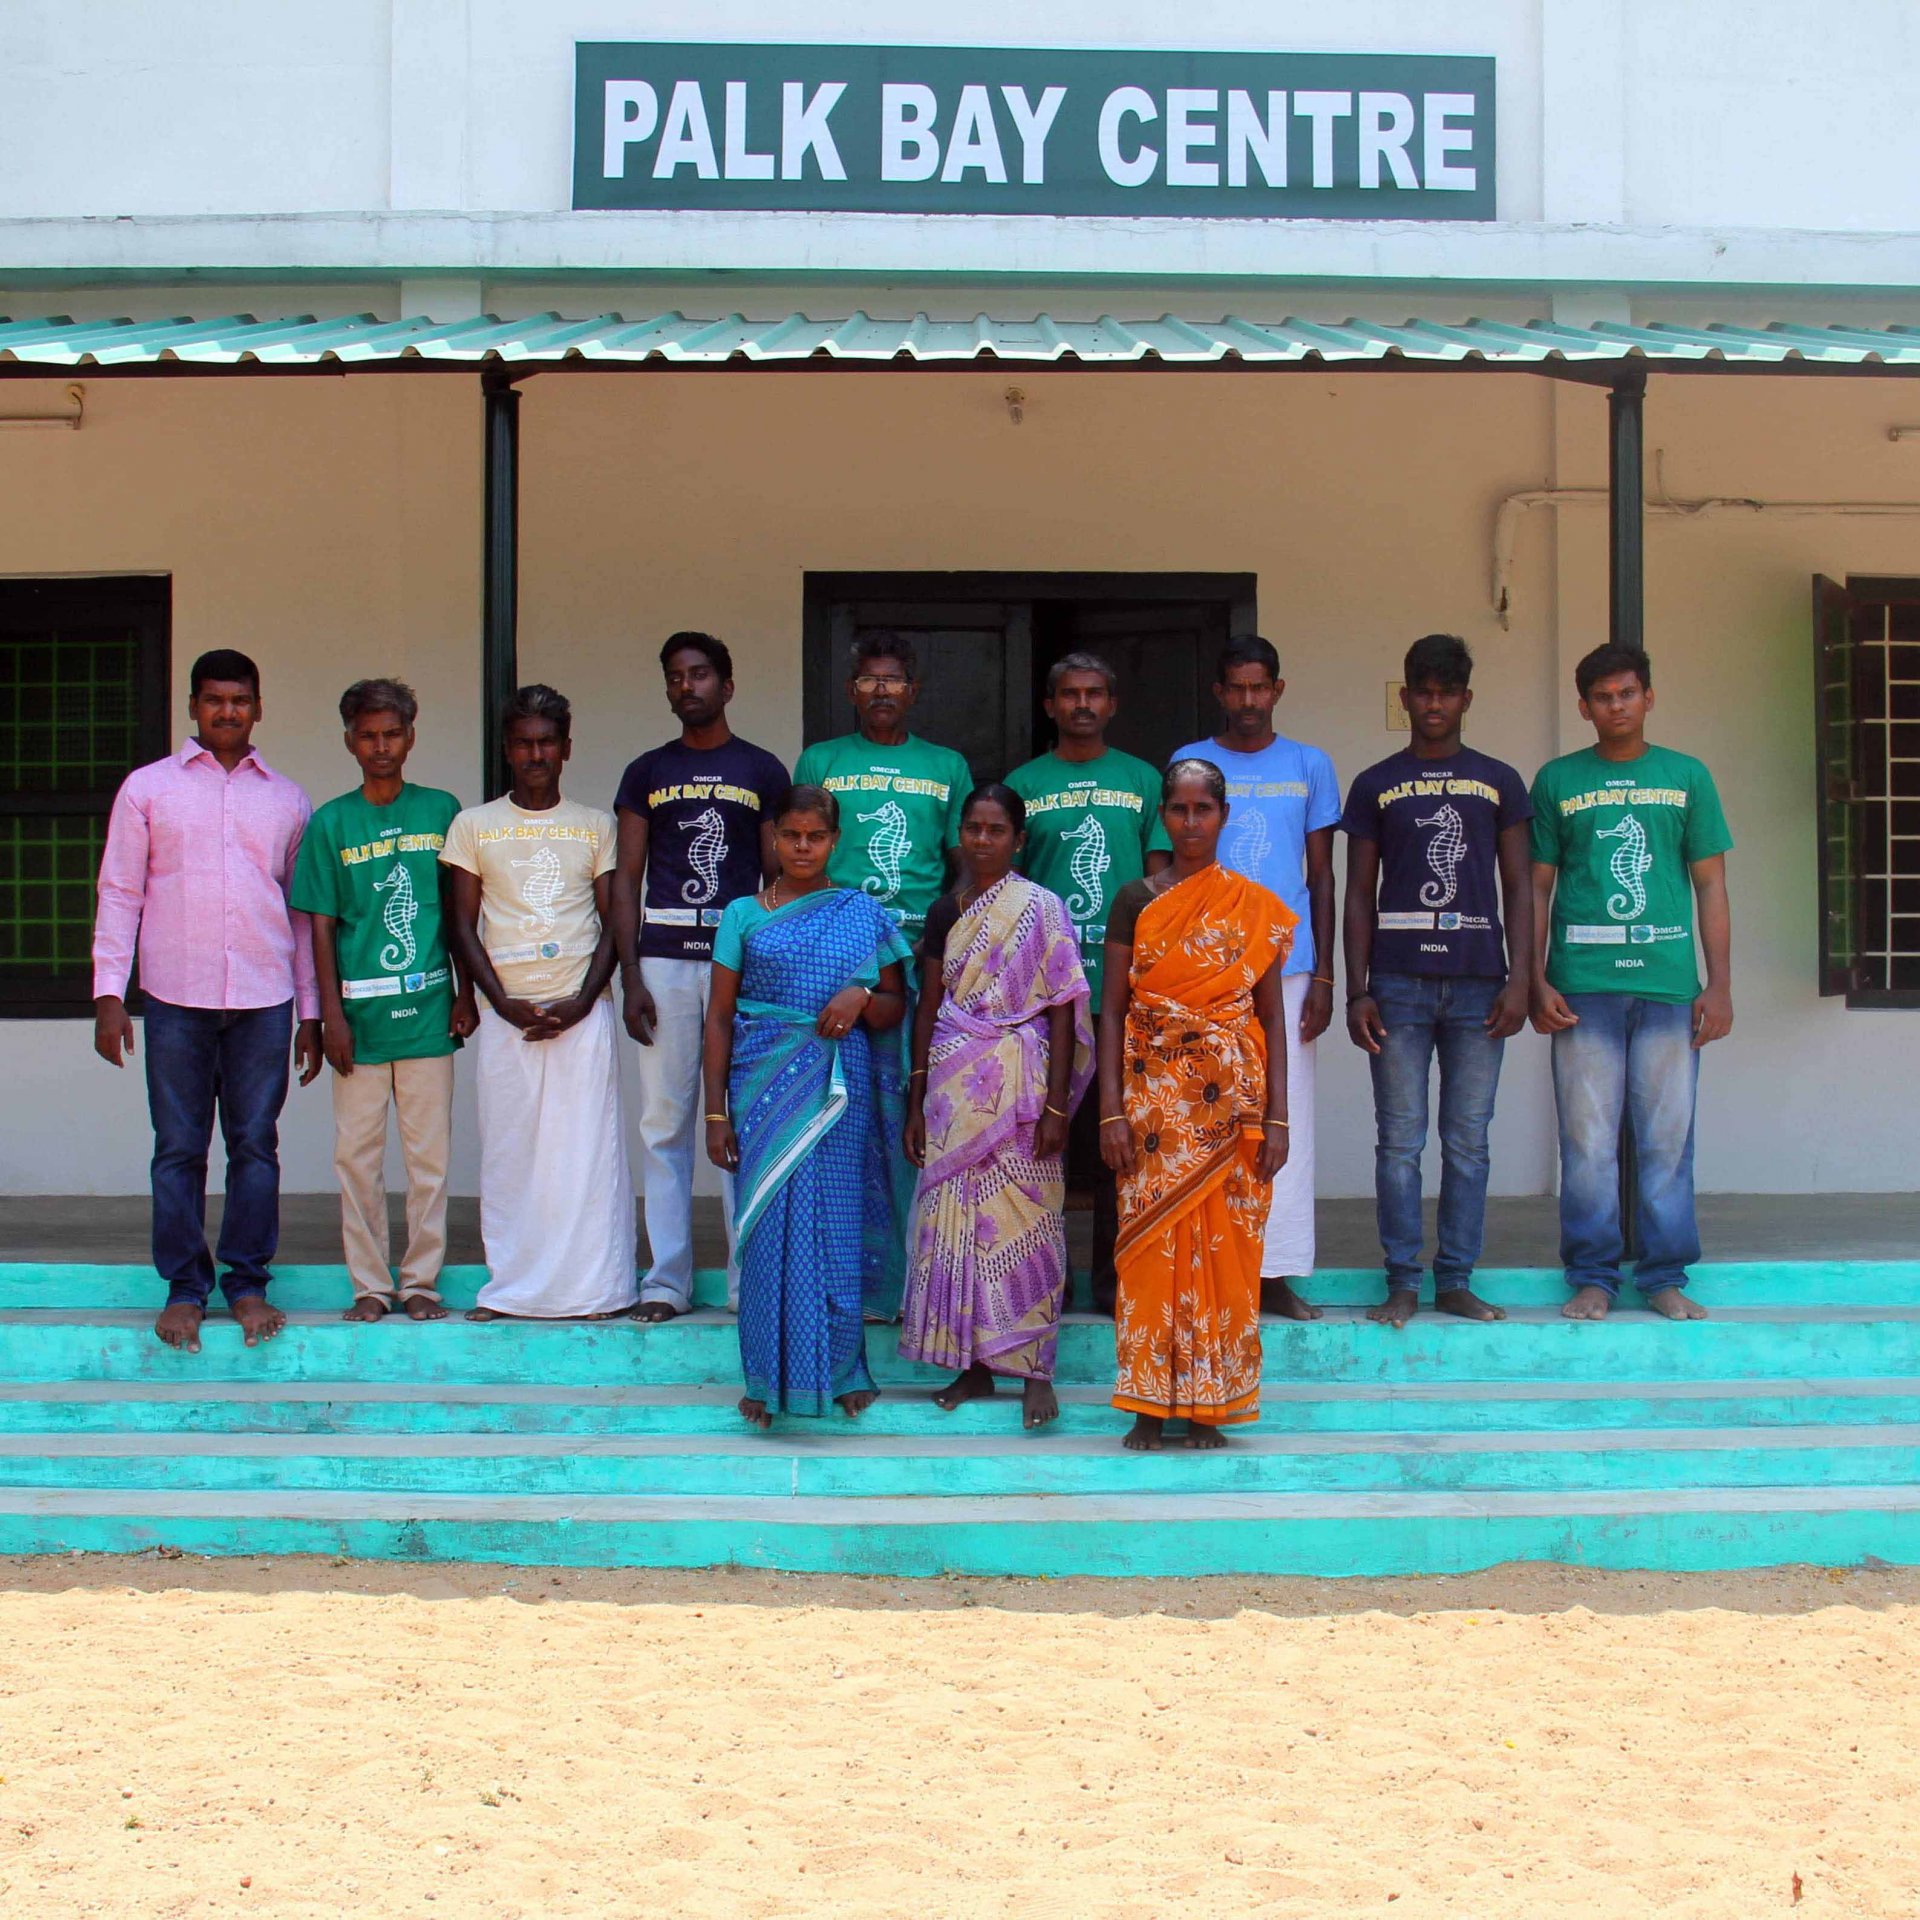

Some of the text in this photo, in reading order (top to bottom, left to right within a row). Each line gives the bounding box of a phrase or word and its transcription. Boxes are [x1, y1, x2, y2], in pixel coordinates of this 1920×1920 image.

[603, 80, 1476, 191] PALK BAY CENTRE
[682, 784, 714, 799] BAY
[822, 774, 950, 802] PALK BAY CENTRE
[1378, 781, 1415, 809] PALK
[1414, 780, 1445, 796] BAY
[1024, 788, 1143, 817] PALK BAY CENTRE
[1560, 788, 1687, 817] PALK BAY CENTRE
[515, 826, 547, 840] BAY
[547, 826, 599, 849] CENTRE
[904, 912, 927, 921] OMC
[683, 941, 711, 951] INDIA
[1420, 943, 1449, 953] INDIA
[1081, 958, 1097, 968] DIA
[1615, 959, 1645, 969] INDIA
[391, 1007, 419, 1020] INDIA
